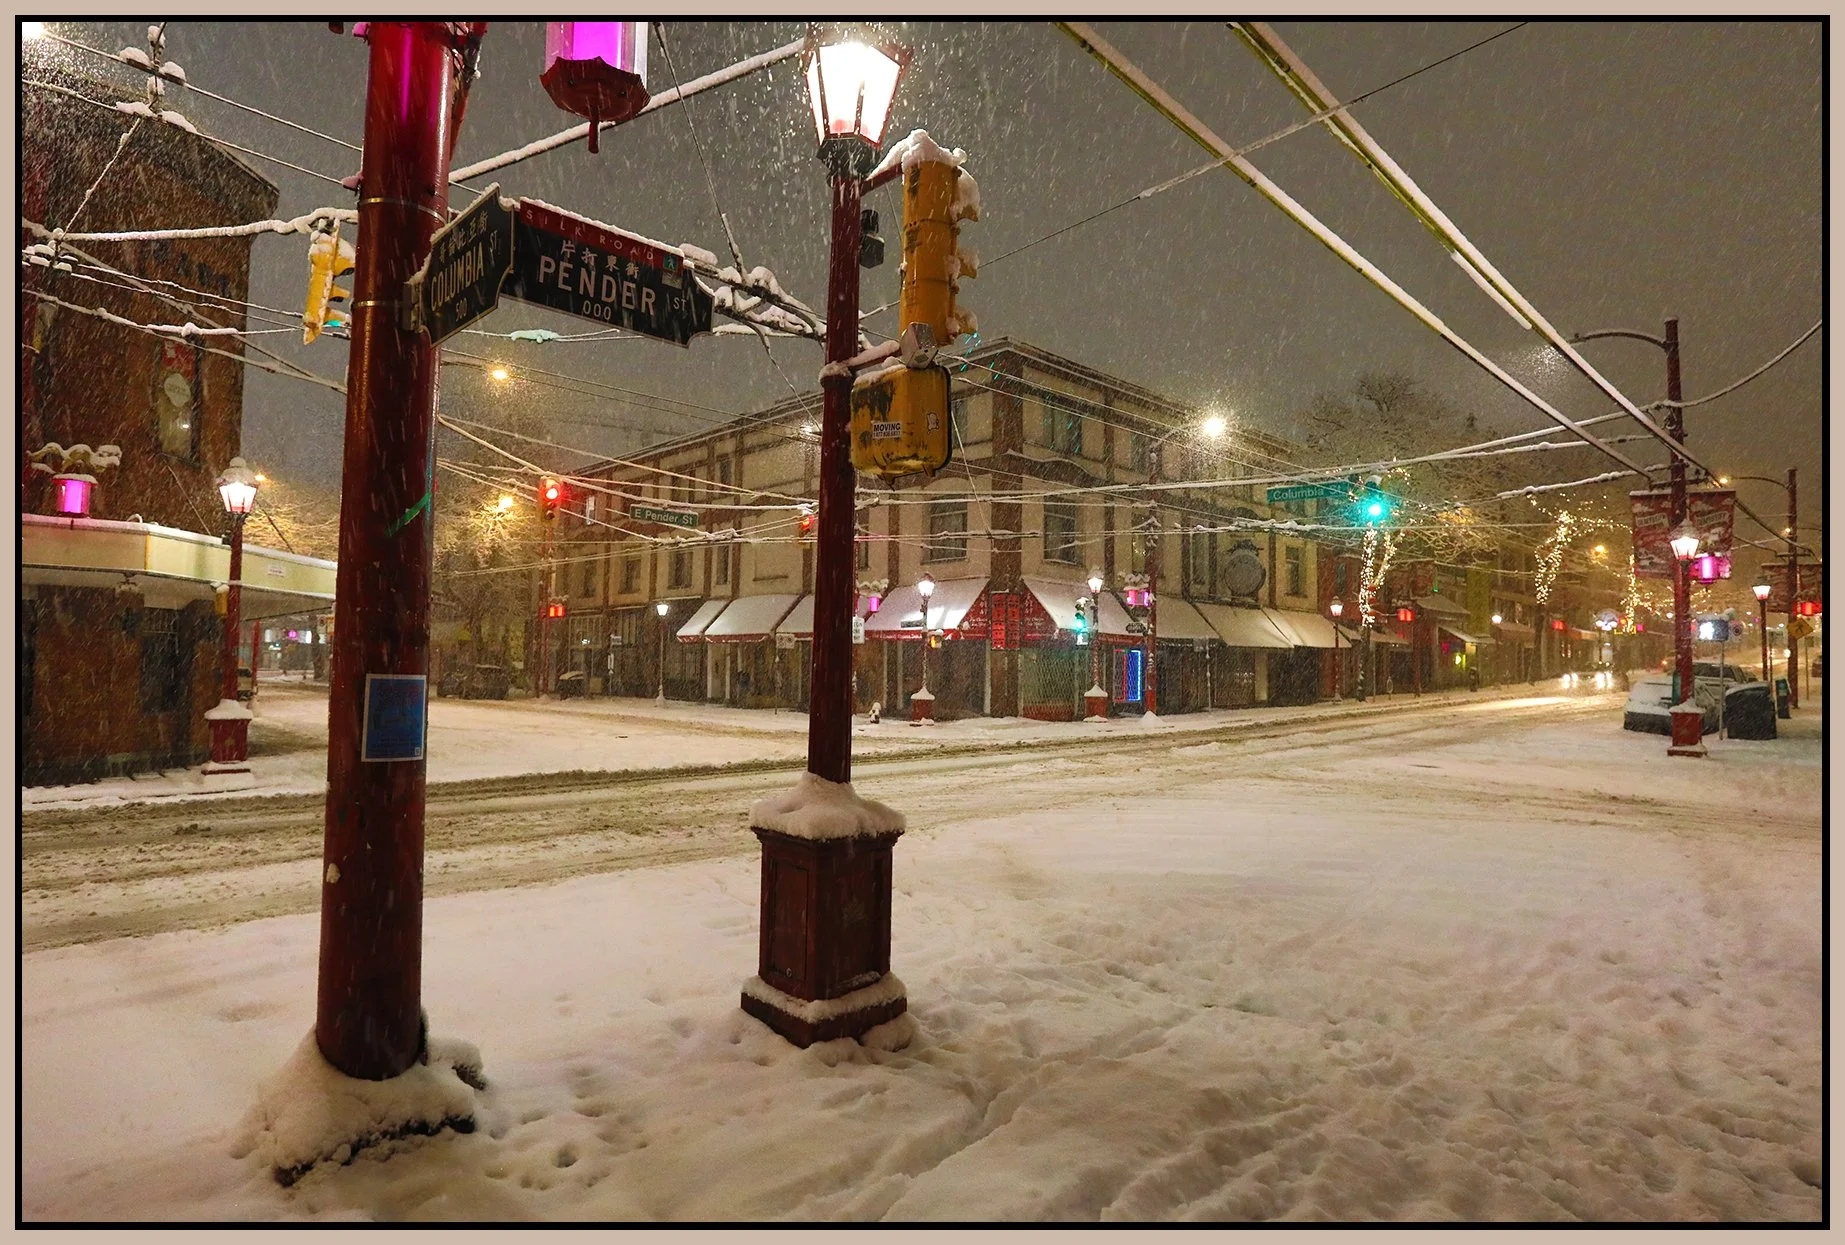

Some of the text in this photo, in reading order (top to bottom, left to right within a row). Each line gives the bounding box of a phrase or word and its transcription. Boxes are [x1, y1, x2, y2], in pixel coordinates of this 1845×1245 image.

[525, 208, 654, 260] SILK ROAD
[431, 241, 484, 312] COLUMBIA
[538, 255, 687, 316] PENDER ST
[456, 297, 468, 322] 500
[583, 300, 612, 320] 000
[873, 422, 901, 432] MOVING
[1273, 487, 1324, 500] Columbia
[634, 508, 693, 525] E Pender St
